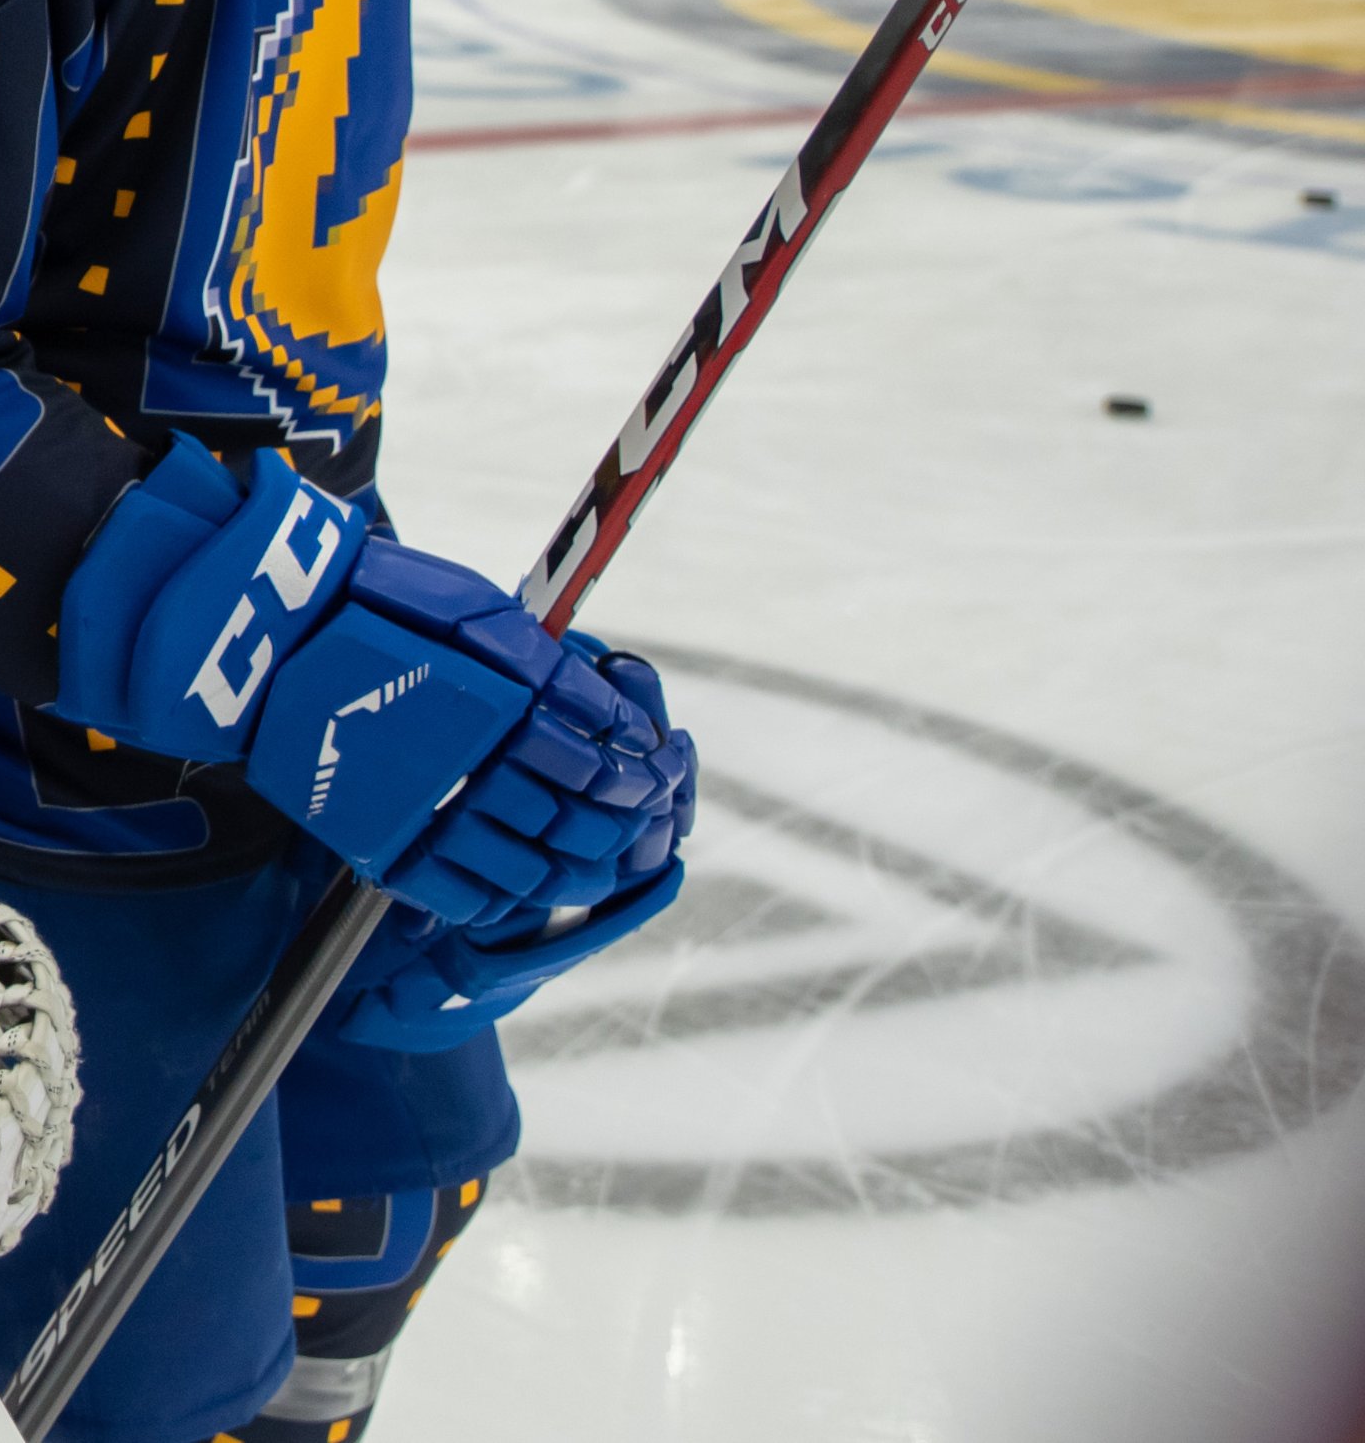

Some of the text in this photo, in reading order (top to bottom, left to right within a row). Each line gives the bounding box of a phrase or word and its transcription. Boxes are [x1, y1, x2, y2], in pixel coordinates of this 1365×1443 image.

[523, 157, 810, 623] CCM
[183, 477, 352, 729] CC
[5, 1103, 201, 1405] SPEED
